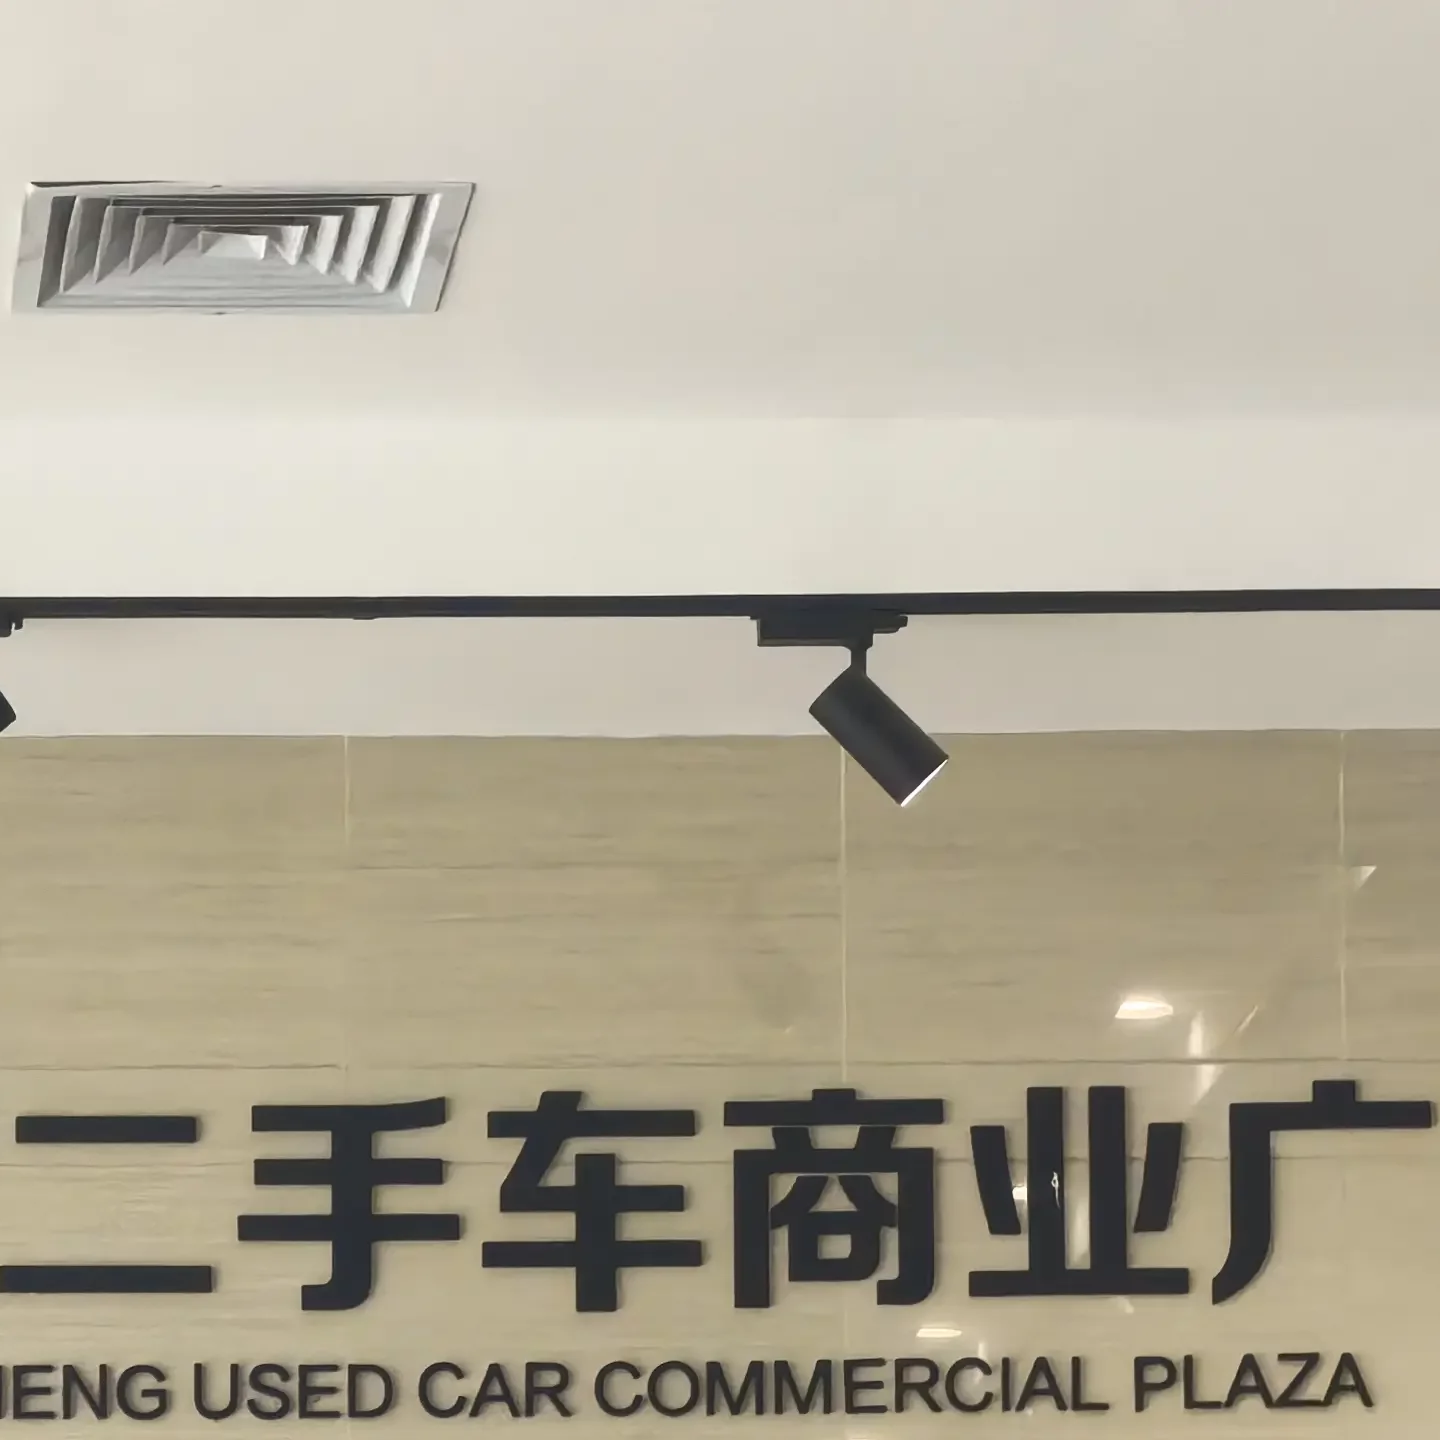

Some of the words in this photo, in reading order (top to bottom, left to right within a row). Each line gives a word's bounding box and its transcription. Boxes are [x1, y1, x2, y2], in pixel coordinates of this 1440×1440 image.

[193, 1362, 395, 1422] USED
[417, 1360, 574, 1420] CAR
[593, 1355, 1111, 1419] COMMERCIAL
[1132, 1351, 1376, 1414] PLAZA
